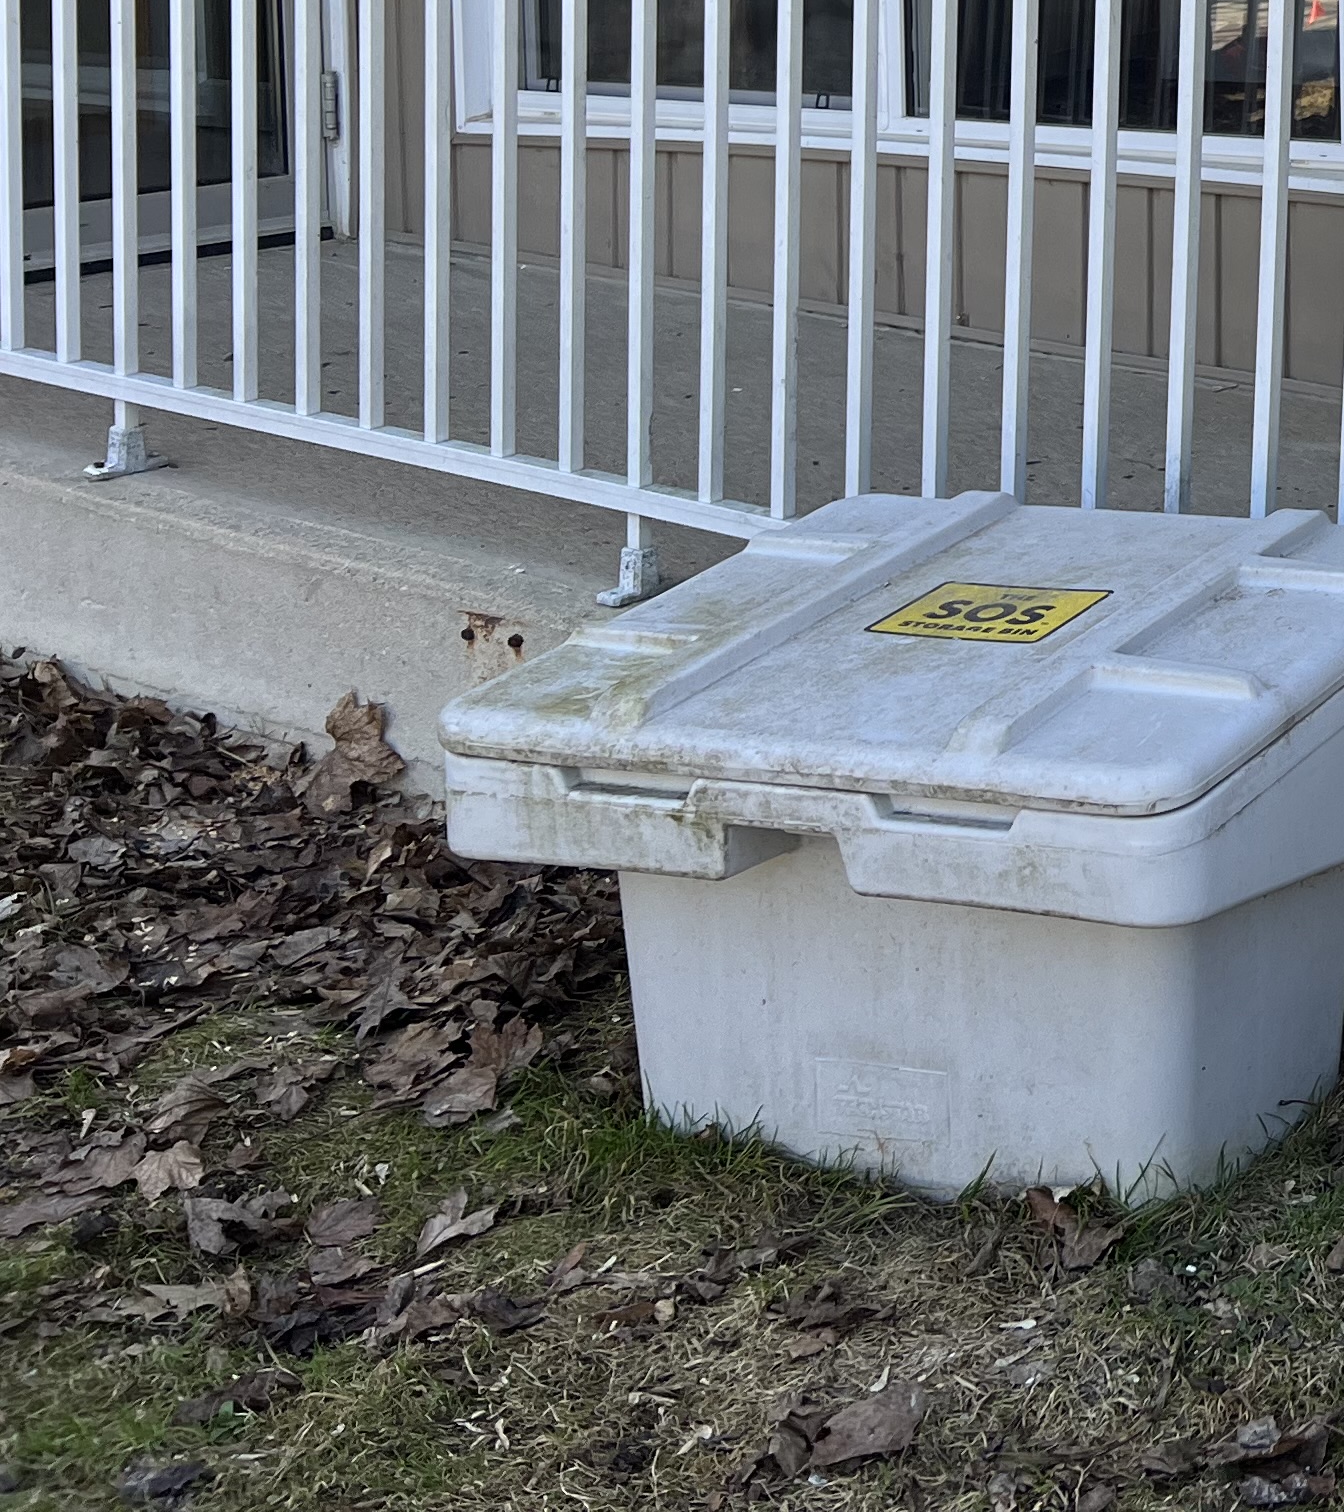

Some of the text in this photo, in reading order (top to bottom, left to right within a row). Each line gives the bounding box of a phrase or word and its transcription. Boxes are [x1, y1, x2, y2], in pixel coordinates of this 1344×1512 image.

[923, 599, 1057, 625] SOS
[898, 620, 1038, 635] STORAGE BIN
